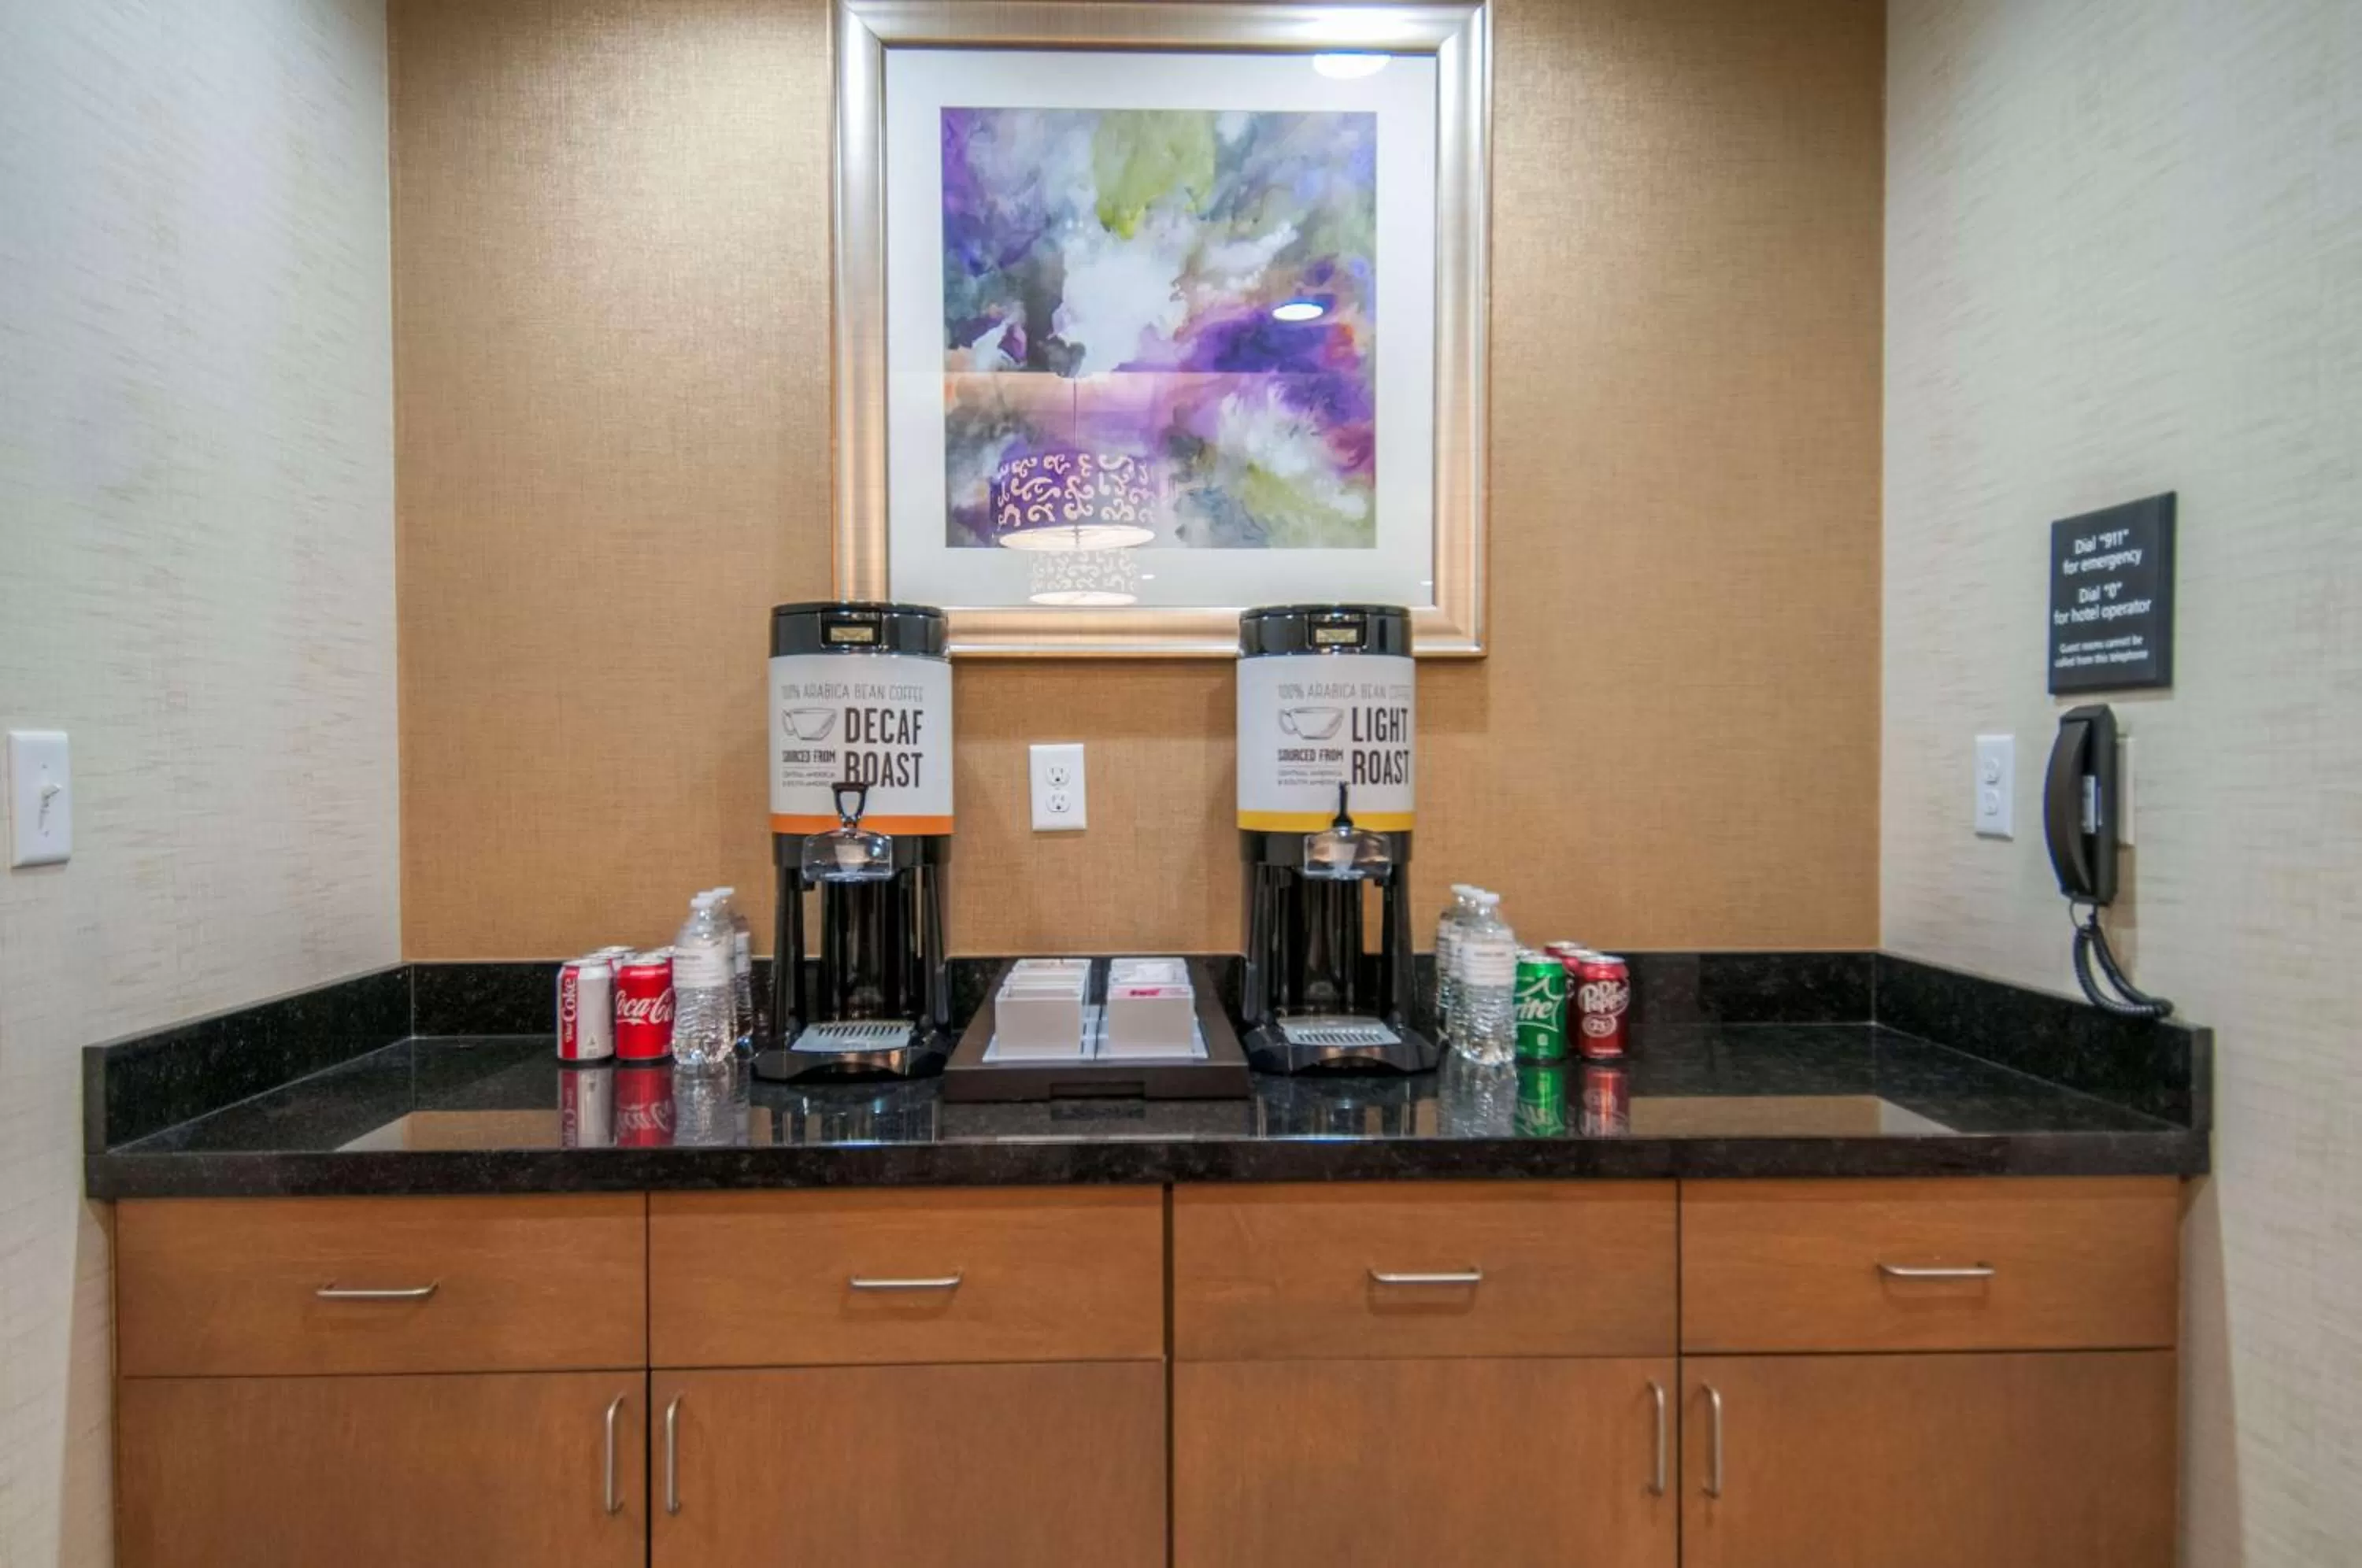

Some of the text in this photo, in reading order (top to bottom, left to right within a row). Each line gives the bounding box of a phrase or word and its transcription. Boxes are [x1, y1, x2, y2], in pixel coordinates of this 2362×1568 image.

[2075, 534, 2097, 554] Dial
[2063, 549, 2142, 575] for emergency
[2079, 586, 2101, 604] Dial
[2054, 599, 2152, 625] for hotel operator
[803, 682, 850, 700] ARABICA
[854, 683, 885, 700] BEAN
[1307, 682, 1356, 700] ARABICA
[1361, 683, 1386, 700] BEAN
[844, 708, 924, 745] DECAF
[1352, 708, 1409, 742] LIGHT
[813, 749, 836, 763] FROM
[1319, 748, 1343, 762] FROM
[844, 751, 924, 788] ROAST
[1352, 749, 1411, 786] ROAST
